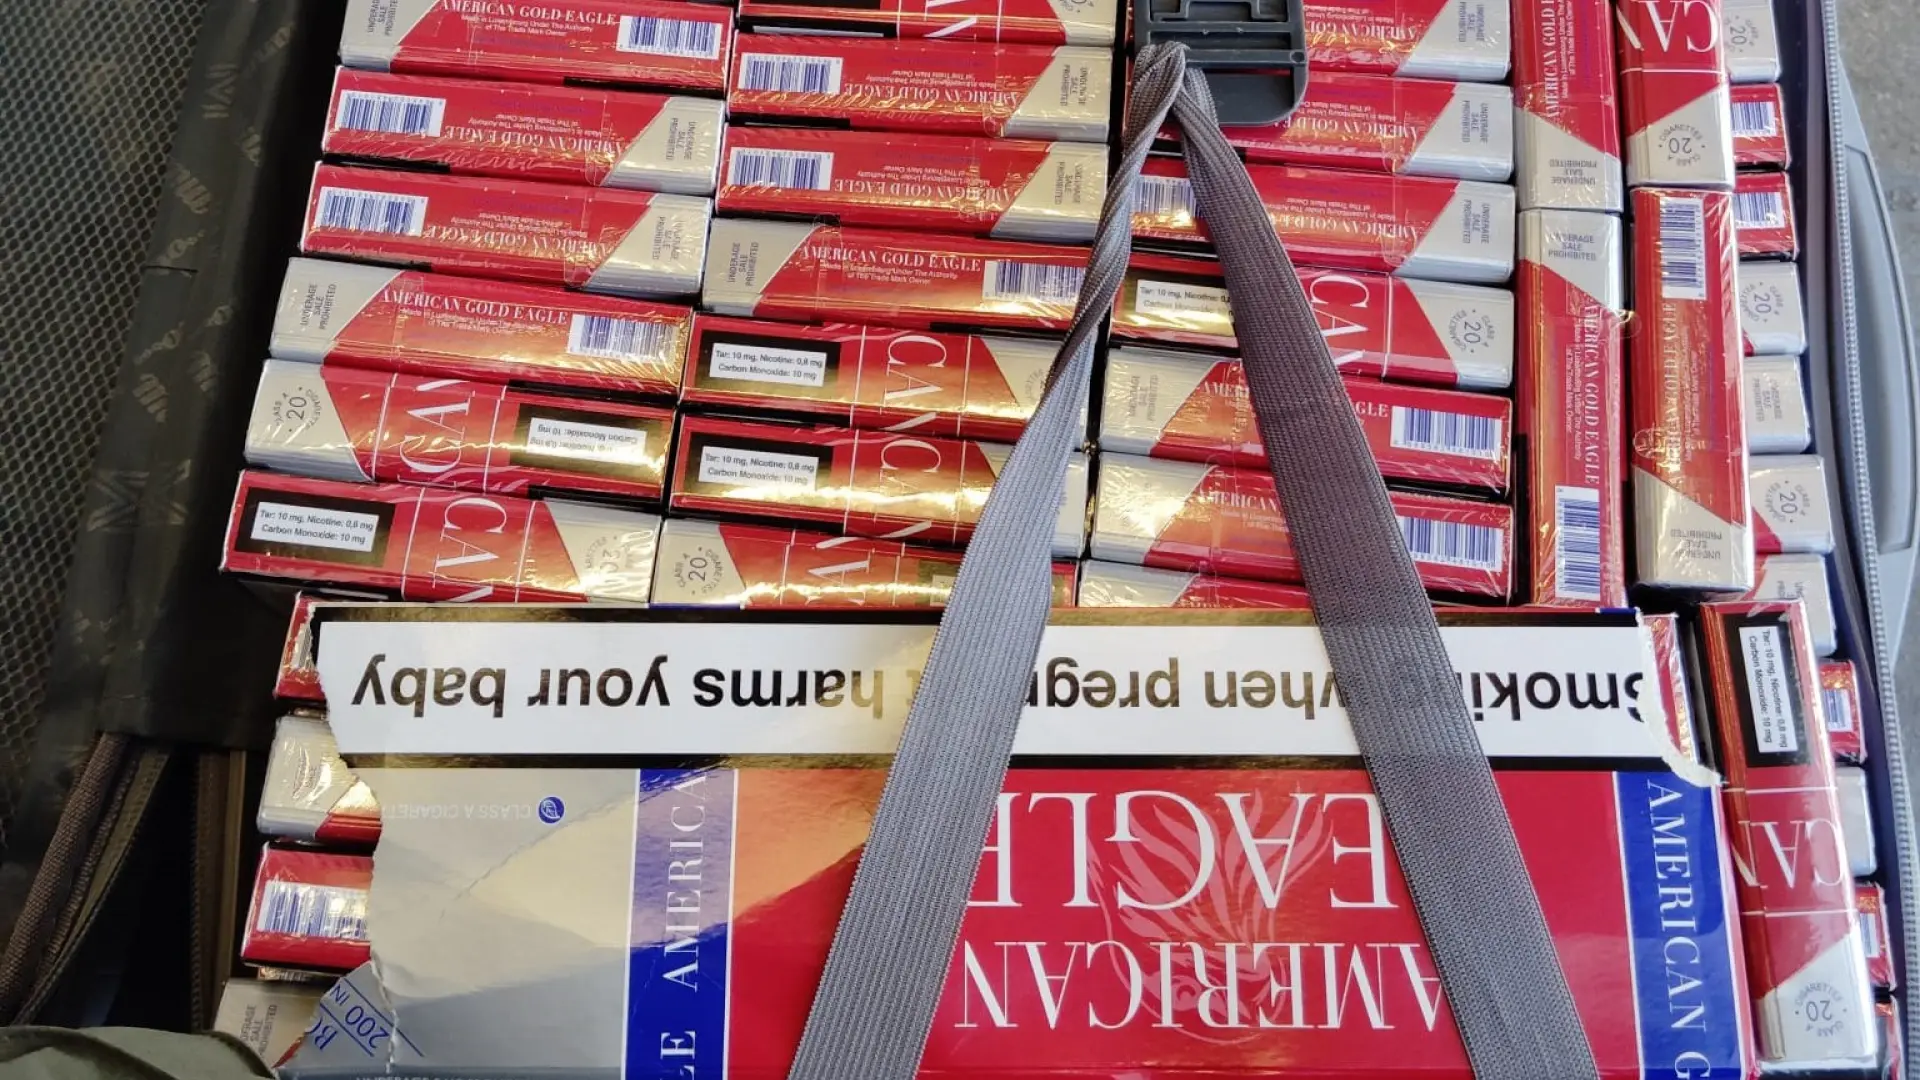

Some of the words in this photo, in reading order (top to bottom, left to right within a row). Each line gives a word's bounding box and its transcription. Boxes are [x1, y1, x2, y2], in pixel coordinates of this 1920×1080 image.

[442, 0, 516, 16] AMERICAN
[520, 6, 561, 20] GOLD
[564, 10, 617, 26] EAGLE
[1342, 22, 1417, 40] AMERICAN
[1540, 8, 1556, 46] GOLD
[1730, 26, 1747, 45] 20
[843, 83, 895, 100] EAGLE
[899, 86, 940, 101] GOLD
[1060, 64, 1071, 106] PROHIBITED
[1544, 50, 1560, 118] AMERICAN
[944, 88, 1020, 109] AMERICAN
[1297, 117, 1338, 130] GOLD
[1344, 121, 1418, 141] AMERICAN
[1660, 123, 1703, 142] CIGARETTES
[444, 126, 497, 145] EAGLE
[501, 130, 544, 148] GOLD
[1668, 137, 1692, 154] 20
[548, 136, 622, 157] AMERICAN
[834, 179, 886, 195] EAGLE
[890, 182, 932, 198] GOLD
[1294, 216, 1337, 231] GOLD
[1341, 219, 1418, 240] AMERICAN
[1462, 200, 1472, 244] PROHIBITED
[1472, 213, 1480, 232] SALE
[1480, 202, 1490, 244] UNDERAGE
[484, 230, 527, 248] GOLD
[1562, 242, 1582, 250] SALE
[727, 242, 741, 282] UNDERAGE
[738, 254, 748, 274] SALE
[746, 241, 760, 287] PROHIBITED
[800, 245, 878, 264] AMERICAN
[882, 251, 924, 268] GOLD
[929, 254, 980, 272] EAGLE
[1548, 250, 1597, 262] PROHIBITED
[312, 296, 324, 316] SALE
[319, 284, 336, 329] PROHIBITED
[384, 290, 460, 311] AMERICAN
[466, 300, 509, 318] GOLD
[514, 304, 568, 324] EAGLE
[1754, 292, 1772, 313] 20
[1464, 320, 1482, 344] 20
[1662, 302, 1677, 353] EAGLE
[1584, 304, 1600, 379] AMERICAN
[732, 352, 742, 360] 10
[760, 354, 794, 365] Nicotine:
[810, 360, 822, 369] mg
[718, 363, 747, 373] Carbon
[750, 366, 790, 376] Monoxide:
[792, 370, 802, 378] 10
[803, 372, 816, 381] mg
[286, 397, 307, 420] 20
[1355, 401, 1388, 418] GLE
[1584, 383, 1600, 426] GOLD
[538, 425, 551, 434] mg
[552, 428, 560, 437] 10
[564, 429, 606, 442] Monoxide:
[608, 434, 638, 446] Carbon
[722, 455, 732, 463] 10
[750, 458, 786, 469] Nicotine:
[801, 464, 814, 472] mg
[1584, 431, 1600, 485] EAGLE
[708, 467, 737, 478] Carbon
[1779, 492, 1798, 514] 20
[278, 511, 288, 520] 10
[307, 514, 344, 526] Nicotine:
[360, 522, 374, 532] mg
[262, 524, 292, 534] Carbon
[294, 528, 339, 540] Monoxide:
[341, 532, 350, 542] 10
[352, 535, 366, 545] mg
[688, 557, 708, 581] 20
[1762, 630, 1770, 646] Tar:
[1749, 636, 1762, 667] Carbon
[1765, 648, 1773, 659] 10
[350, 654, 507, 718] baby
[527, 655, 671, 707] your
[1755, 668, 1768, 715] Monoxide:
[693, 669, 884, 719] harms
[1452, 672, 1645, 723] Smoki
[1771, 678, 1784, 717] Nicotine:
[1762, 717, 1770, 726] 10
[1764, 729, 1773, 744] mg
[1779, 734, 1788, 748] mg
[464, 805, 474, 818] A
[662, 775, 707, 992] AMERICA
[1647, 779, 1706, 1030] AMERICAN
[955, 939, 1441, 1031] AMERICAN
[1806, 1000, 1832, 1020] 20
[345, 1006, 390, 1049] 200
